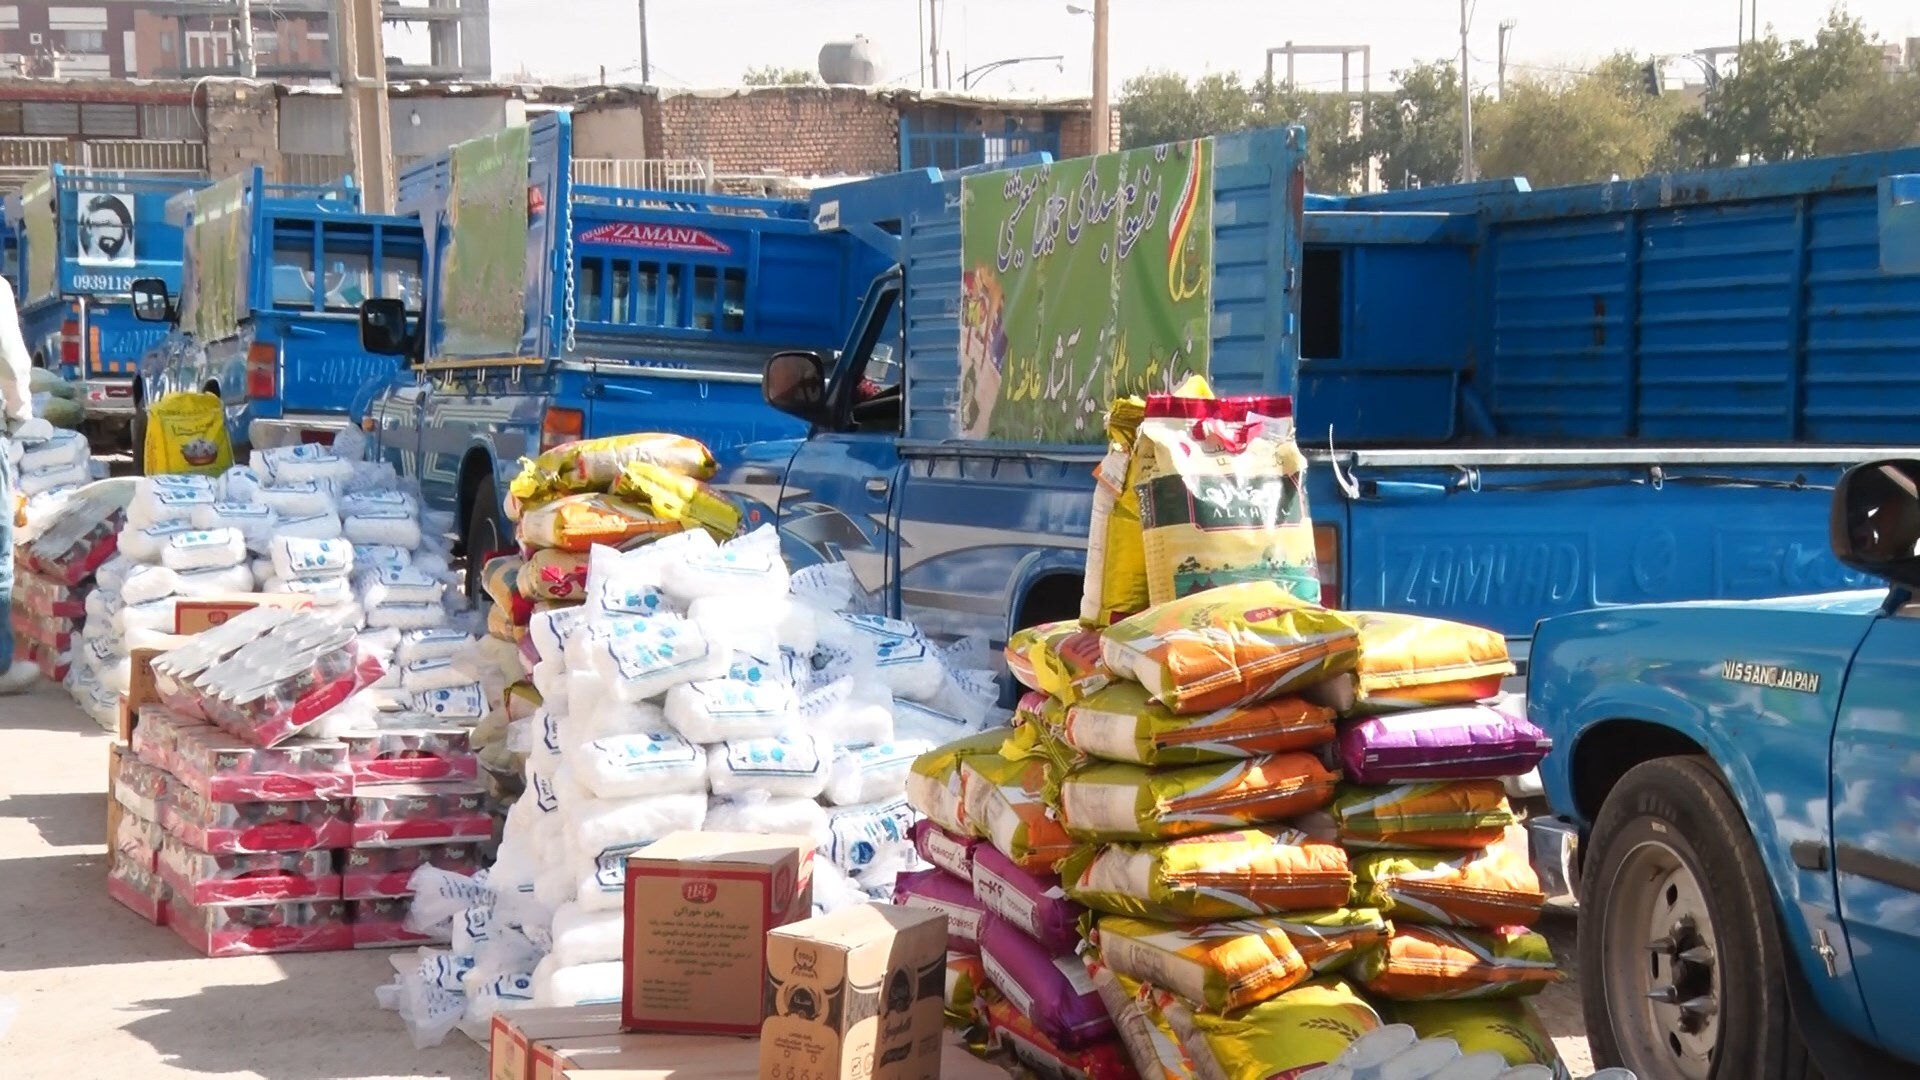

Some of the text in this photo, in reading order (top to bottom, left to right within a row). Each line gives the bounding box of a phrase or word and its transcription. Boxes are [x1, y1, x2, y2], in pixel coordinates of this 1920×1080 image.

[613, 222, 698, 243] ZAMANI
[73, 275, 165, 290] 0939118
[1043, 327, 1082, 413] آبشار
[1395, 541, 1581, 607] ZAMYAD
[1722, 661, 1819, 692] NISSAN JAPAN
